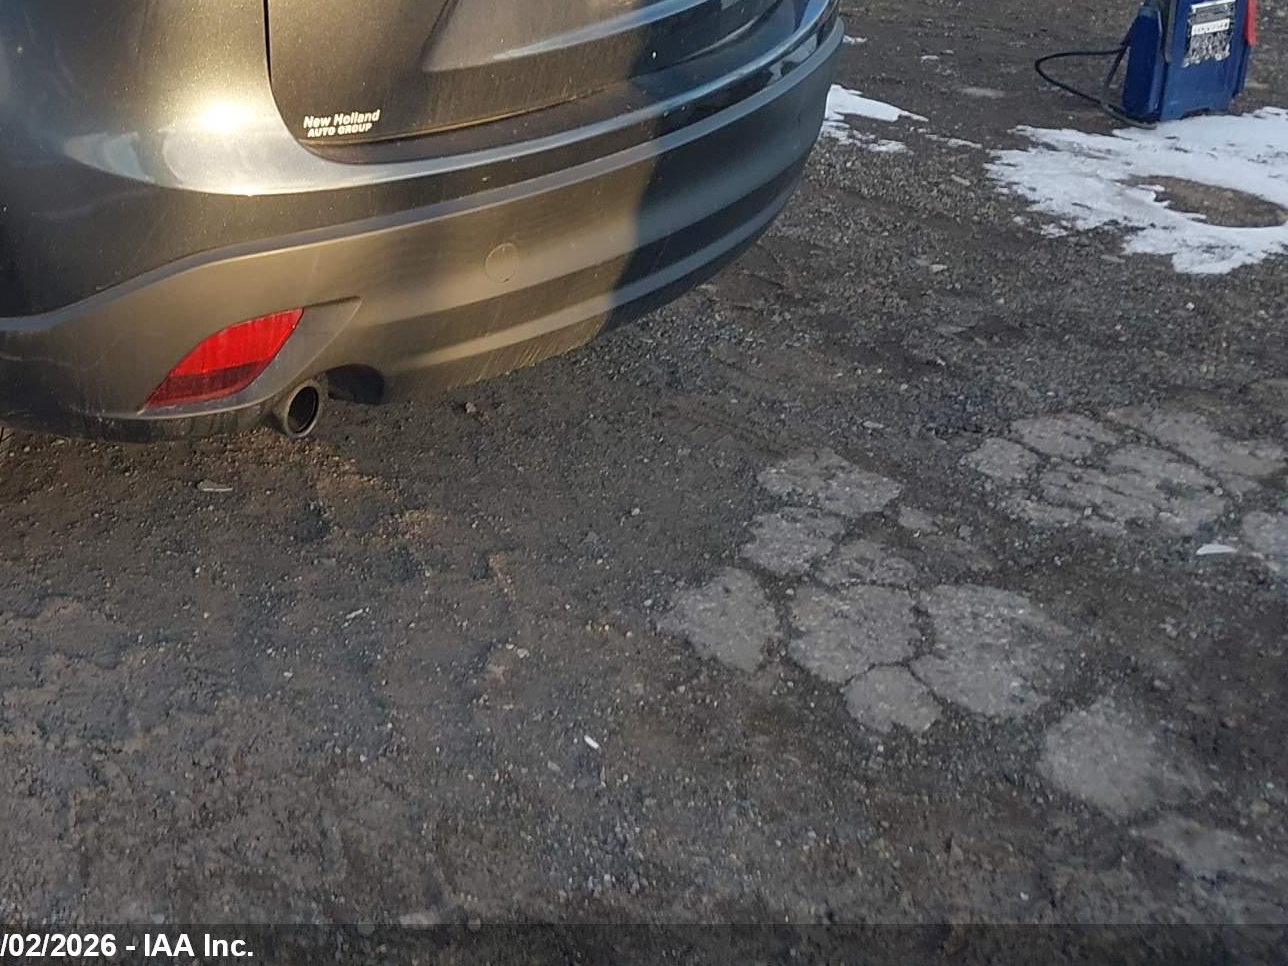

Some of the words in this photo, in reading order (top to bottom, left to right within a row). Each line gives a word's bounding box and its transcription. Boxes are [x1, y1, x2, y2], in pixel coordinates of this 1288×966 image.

[303, 115, 333, 129] New
[333, 109, 381, 126] Holland
[307, 126, 336, 138] AUTO
[337, 122, 373, 135] GROUP
